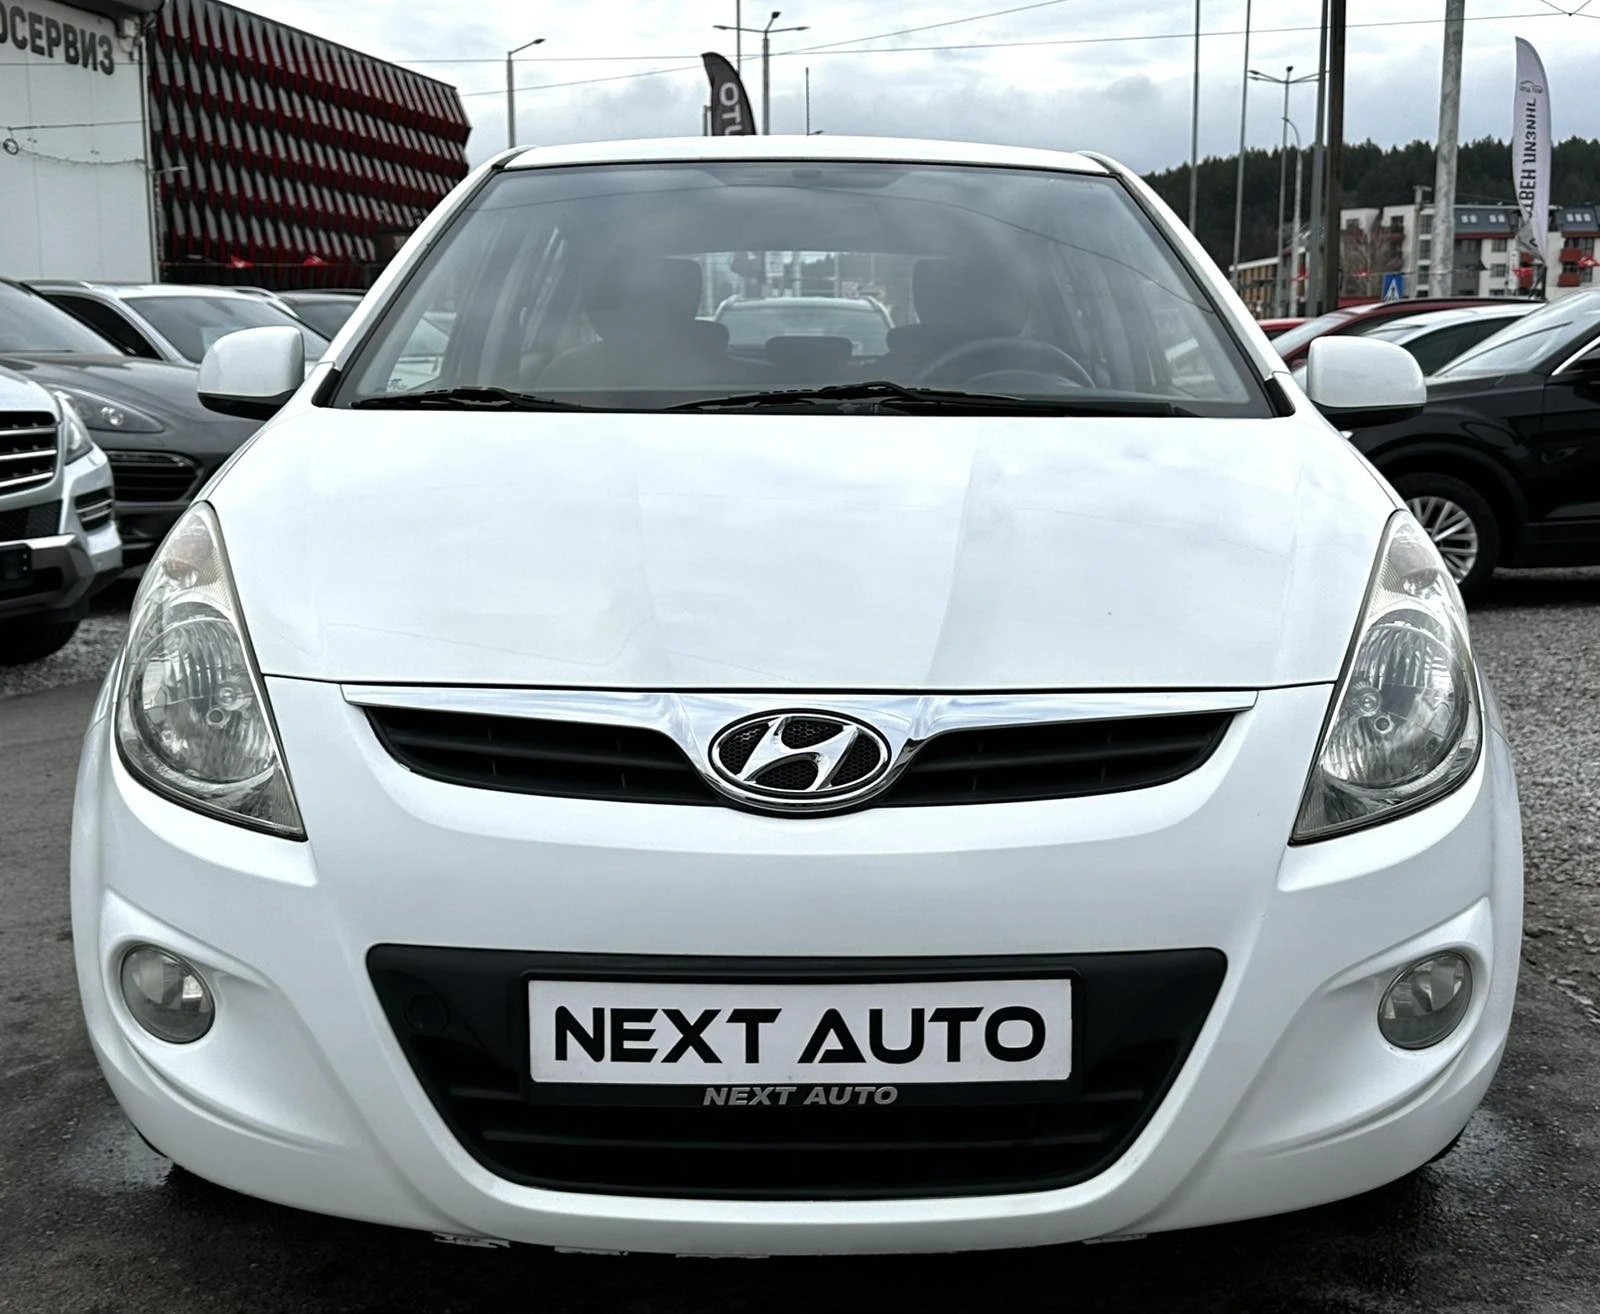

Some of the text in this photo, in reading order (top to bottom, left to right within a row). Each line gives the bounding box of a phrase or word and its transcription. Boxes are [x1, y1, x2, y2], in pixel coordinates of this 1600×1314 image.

[555, 1006, 1046, 1064] NEXT AUTO
[703, 1086, 898, 1106] NEXT AUTO
